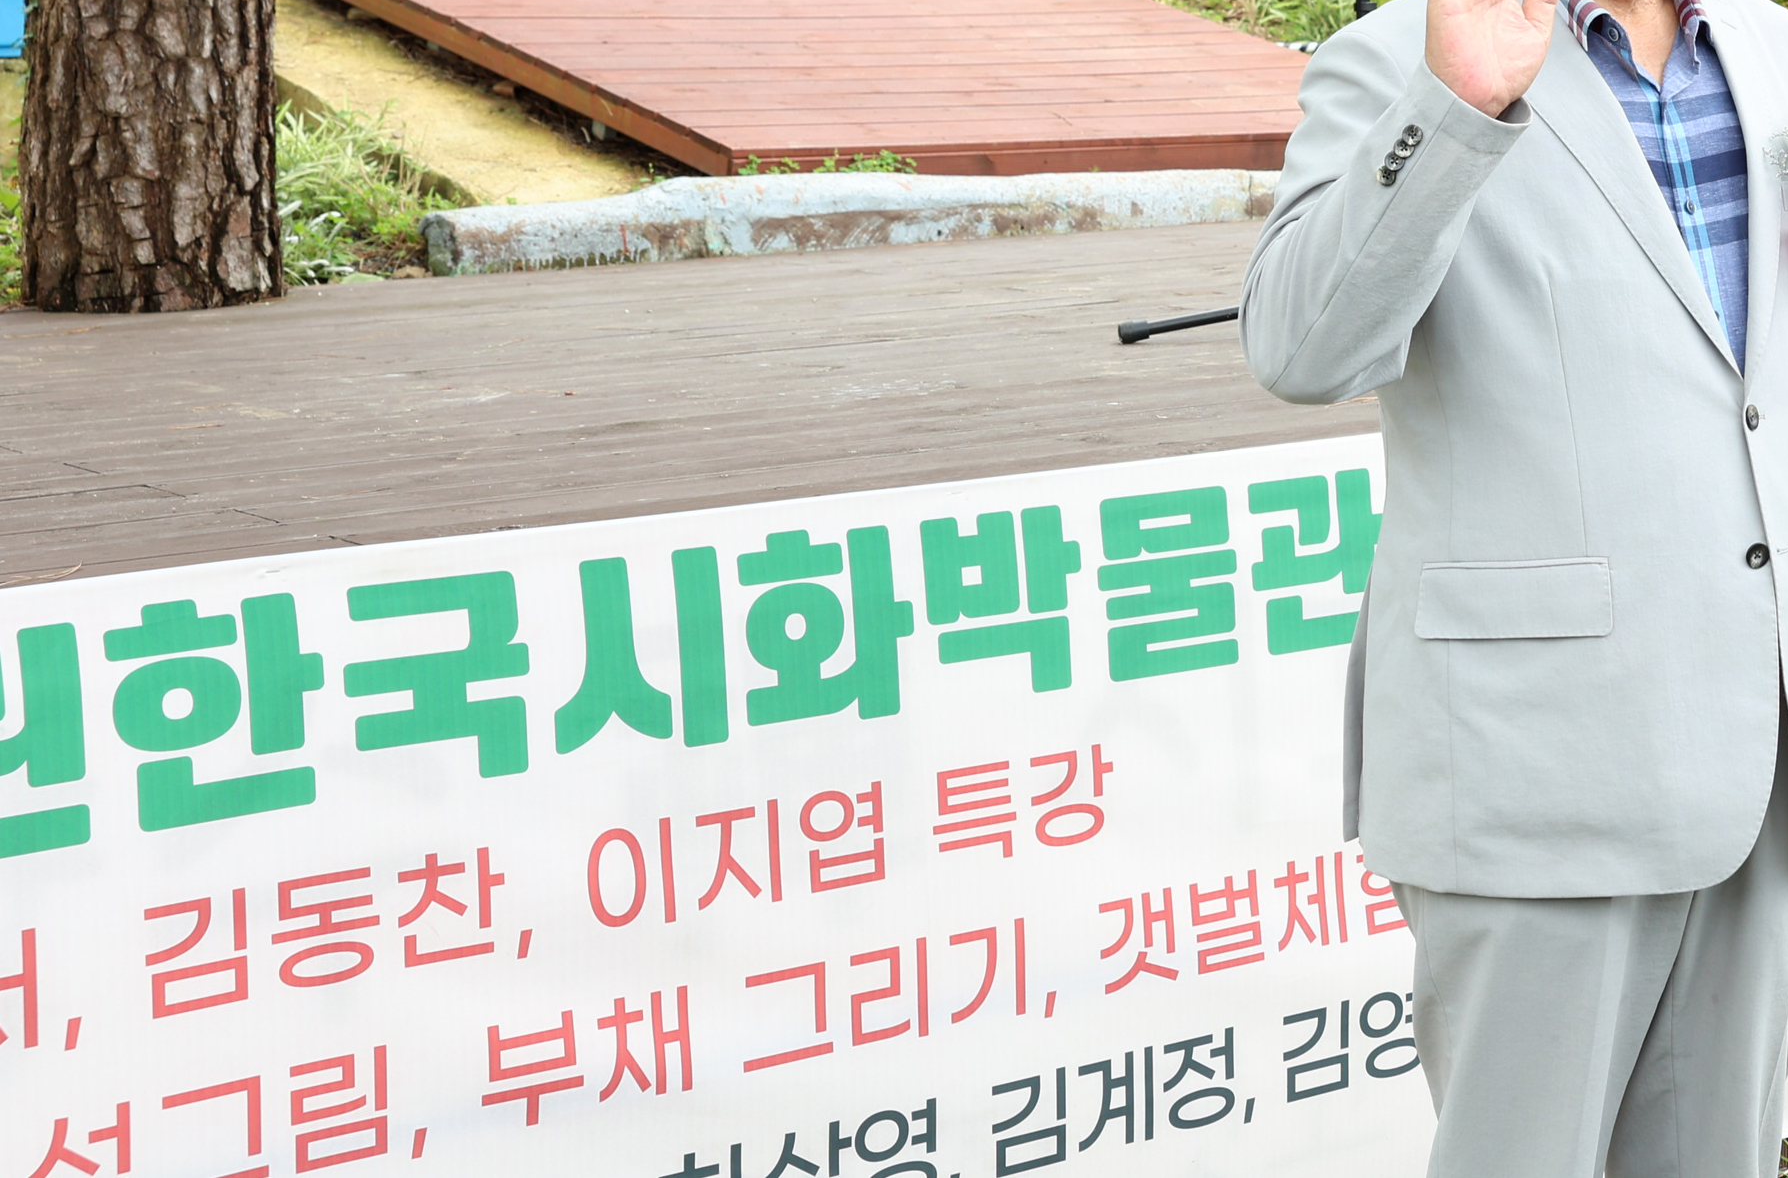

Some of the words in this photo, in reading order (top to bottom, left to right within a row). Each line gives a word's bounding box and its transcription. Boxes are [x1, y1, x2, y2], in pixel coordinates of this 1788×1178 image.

[144, 846, 533, 1020] 김동찬,
[588, 780, 886, 928] 이지엽
[933, 743, 1115, 859] 특강
[481, 984, 695, 1126] 부채
[742, 916, 1058, 1073] 그리기,
[991, 1026, 1256, 1176] 김계정,
